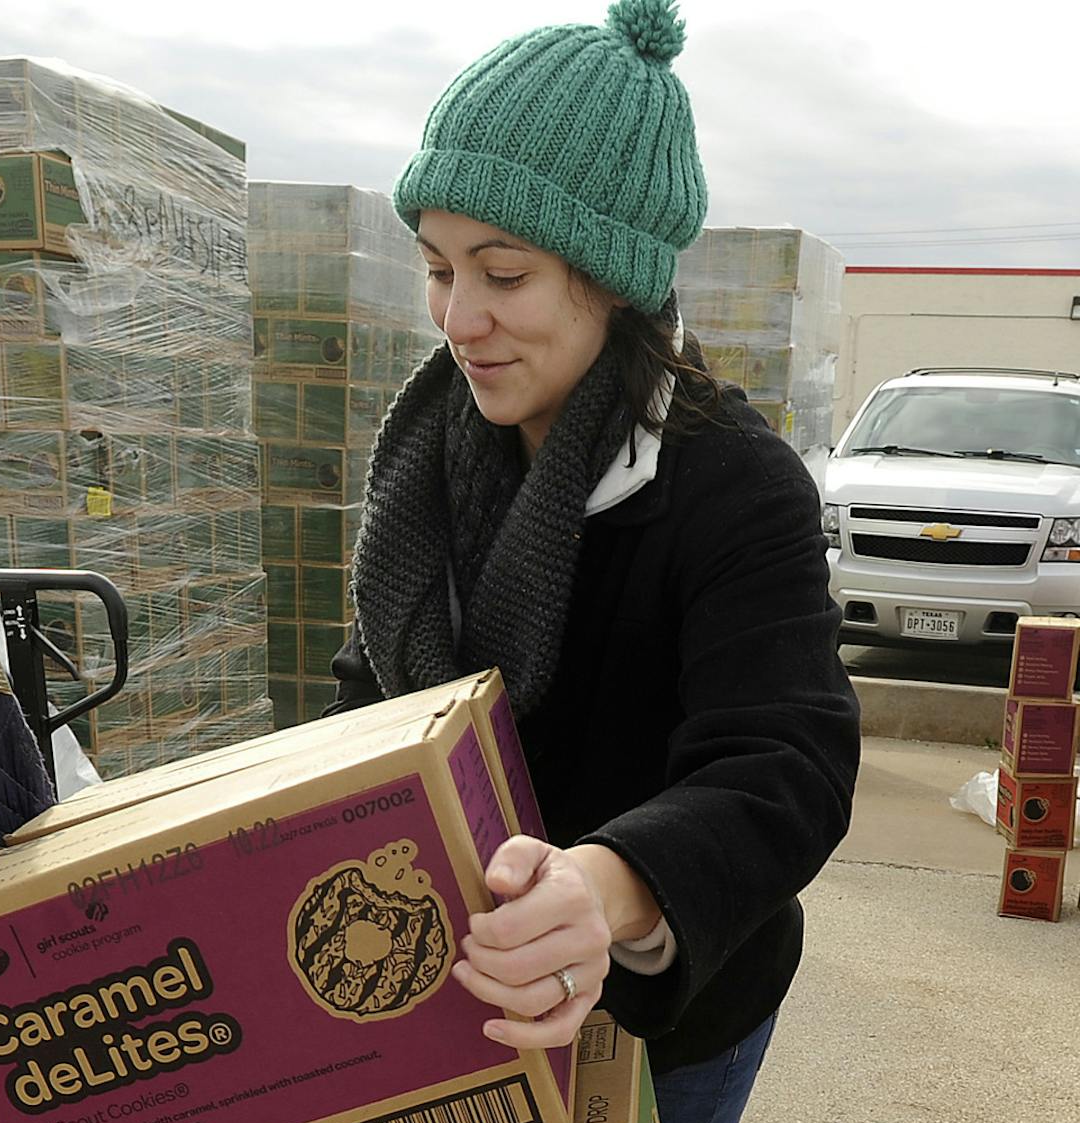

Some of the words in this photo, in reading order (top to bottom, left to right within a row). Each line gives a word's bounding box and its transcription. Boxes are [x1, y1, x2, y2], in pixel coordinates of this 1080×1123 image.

[342, 788, 415, 824] 007002
[36, 935, 57, 954] girl
[58, 923, 97, 945] scouts
[51, 941, 91, 962] cookie
[91, 922, 143, 951] program
[219, 1084, 267, 1108] sprinkled
[268, 1077, 293, 1092] with
[292, 1064, 334, 1085] toasted
